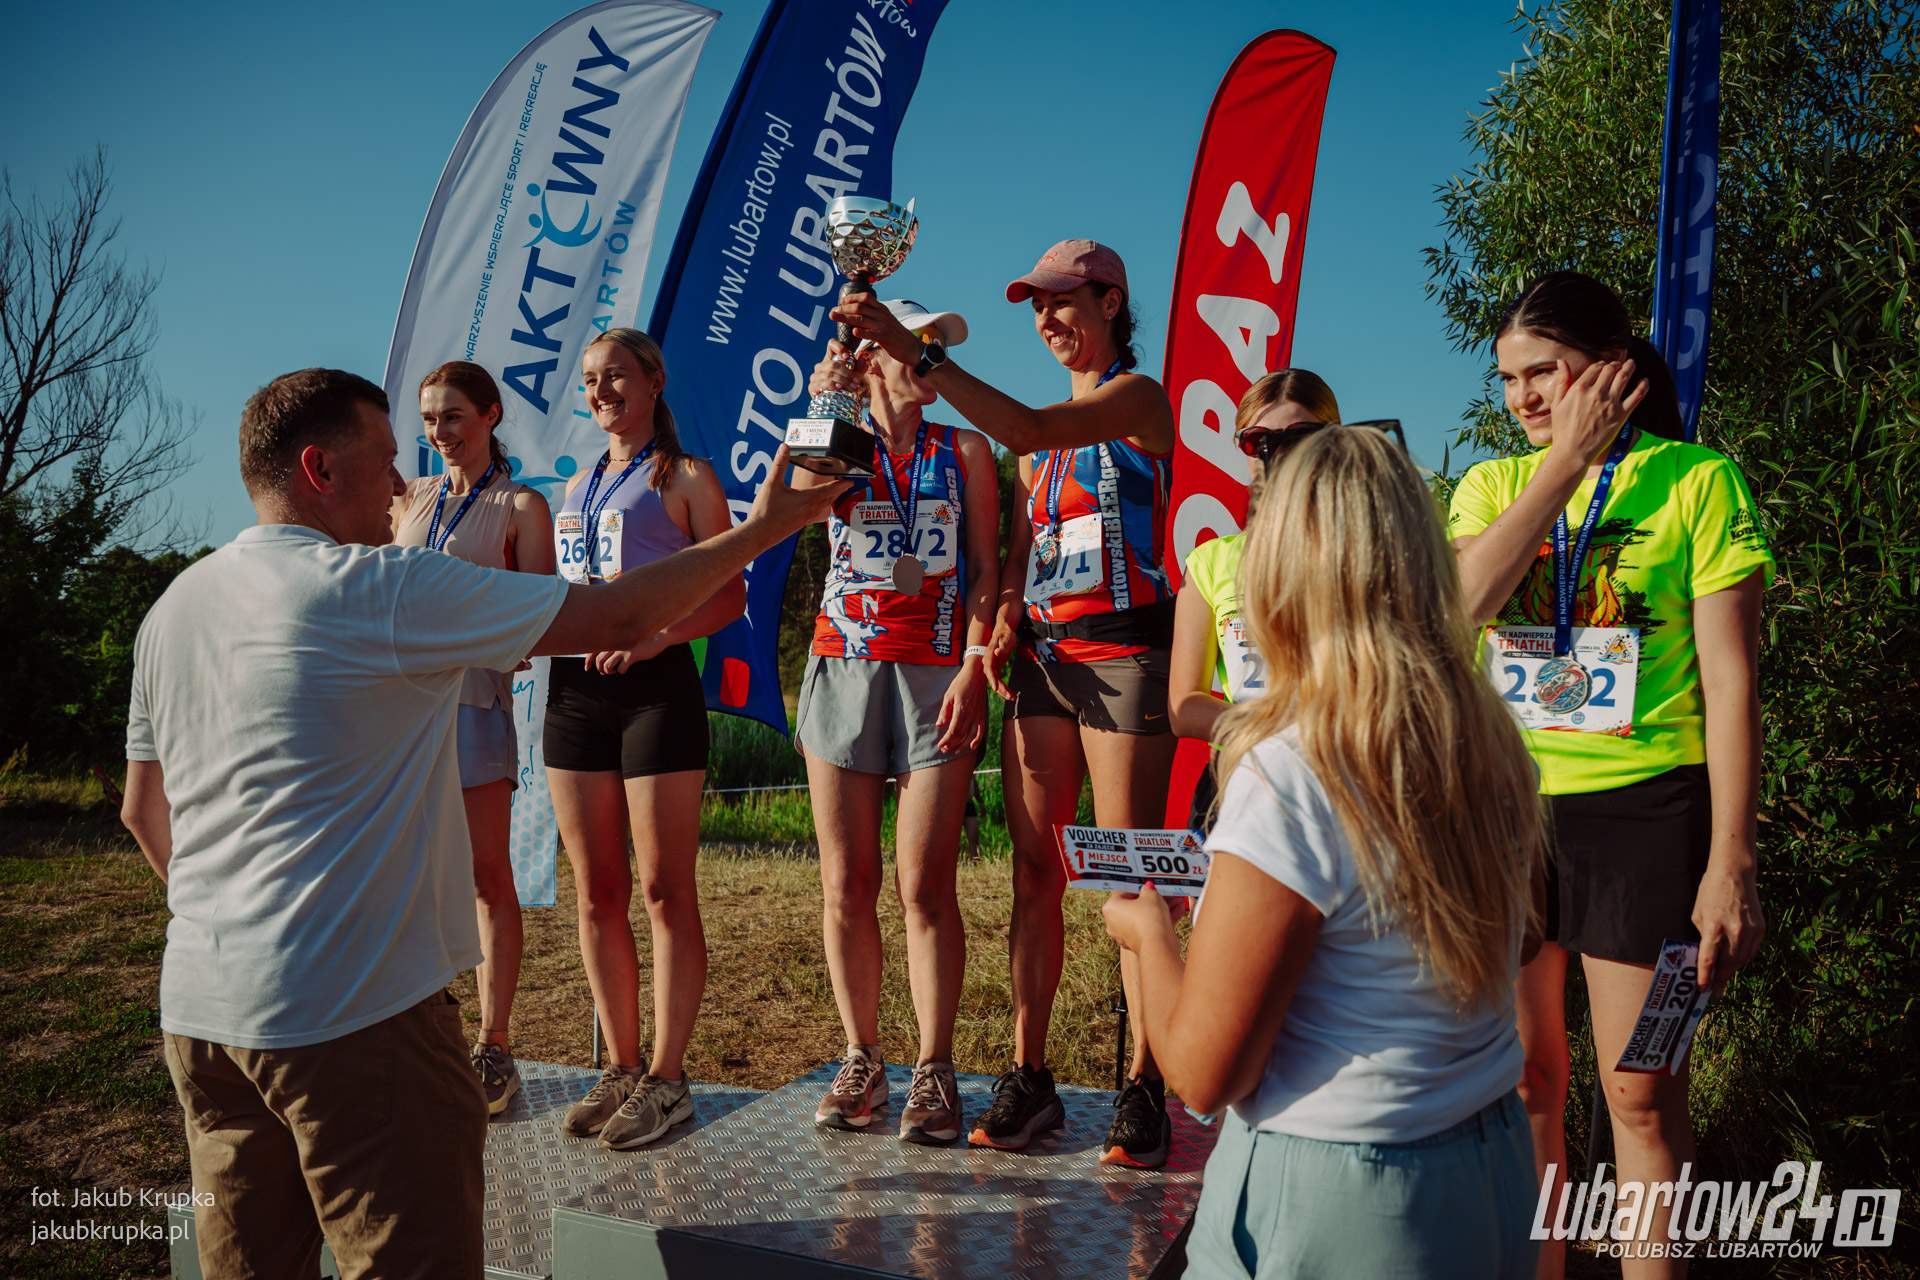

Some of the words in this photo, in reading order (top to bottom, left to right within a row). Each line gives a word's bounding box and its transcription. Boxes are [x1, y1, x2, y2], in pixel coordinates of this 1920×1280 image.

[768, 12, 887, 341] LUBARTÓW
[463, 272, 492, 361] WARZYSZENIE
[485, 183, 514, 269] WSPIERAJĄCE
[505, 139, 525, 182] SPORT
[519, 62, 548, 132] REKREACJĘ
[706, 111, 794, 345] www.lubartow.pl
[573, 200, 637, 419] LARTÓW
[859, 511, 899, 519] TRIATHL
[1557, 511, 1565, 539] TRIATH
[865, 528, 947, 558] 28/2
[1497, 639, 1556, 651] TRIATHL
[1509, 631, 1555, 639] NADWIEPRZA
[1067, 828, 1128, 845] VOUCHER
[1133, 837, 1172, 847] TRIATLON
[1074, 849, 1085, 870] 1
[1088, 852, 1129, 864] MIEJSCA
[1141, 855, 1190, 875] 500
[1669, 966, 1698, 1011] 200
[1622, 1015, 1653, 1063] VOUCHER
[1642, 1053, 1662, 1067] 3
